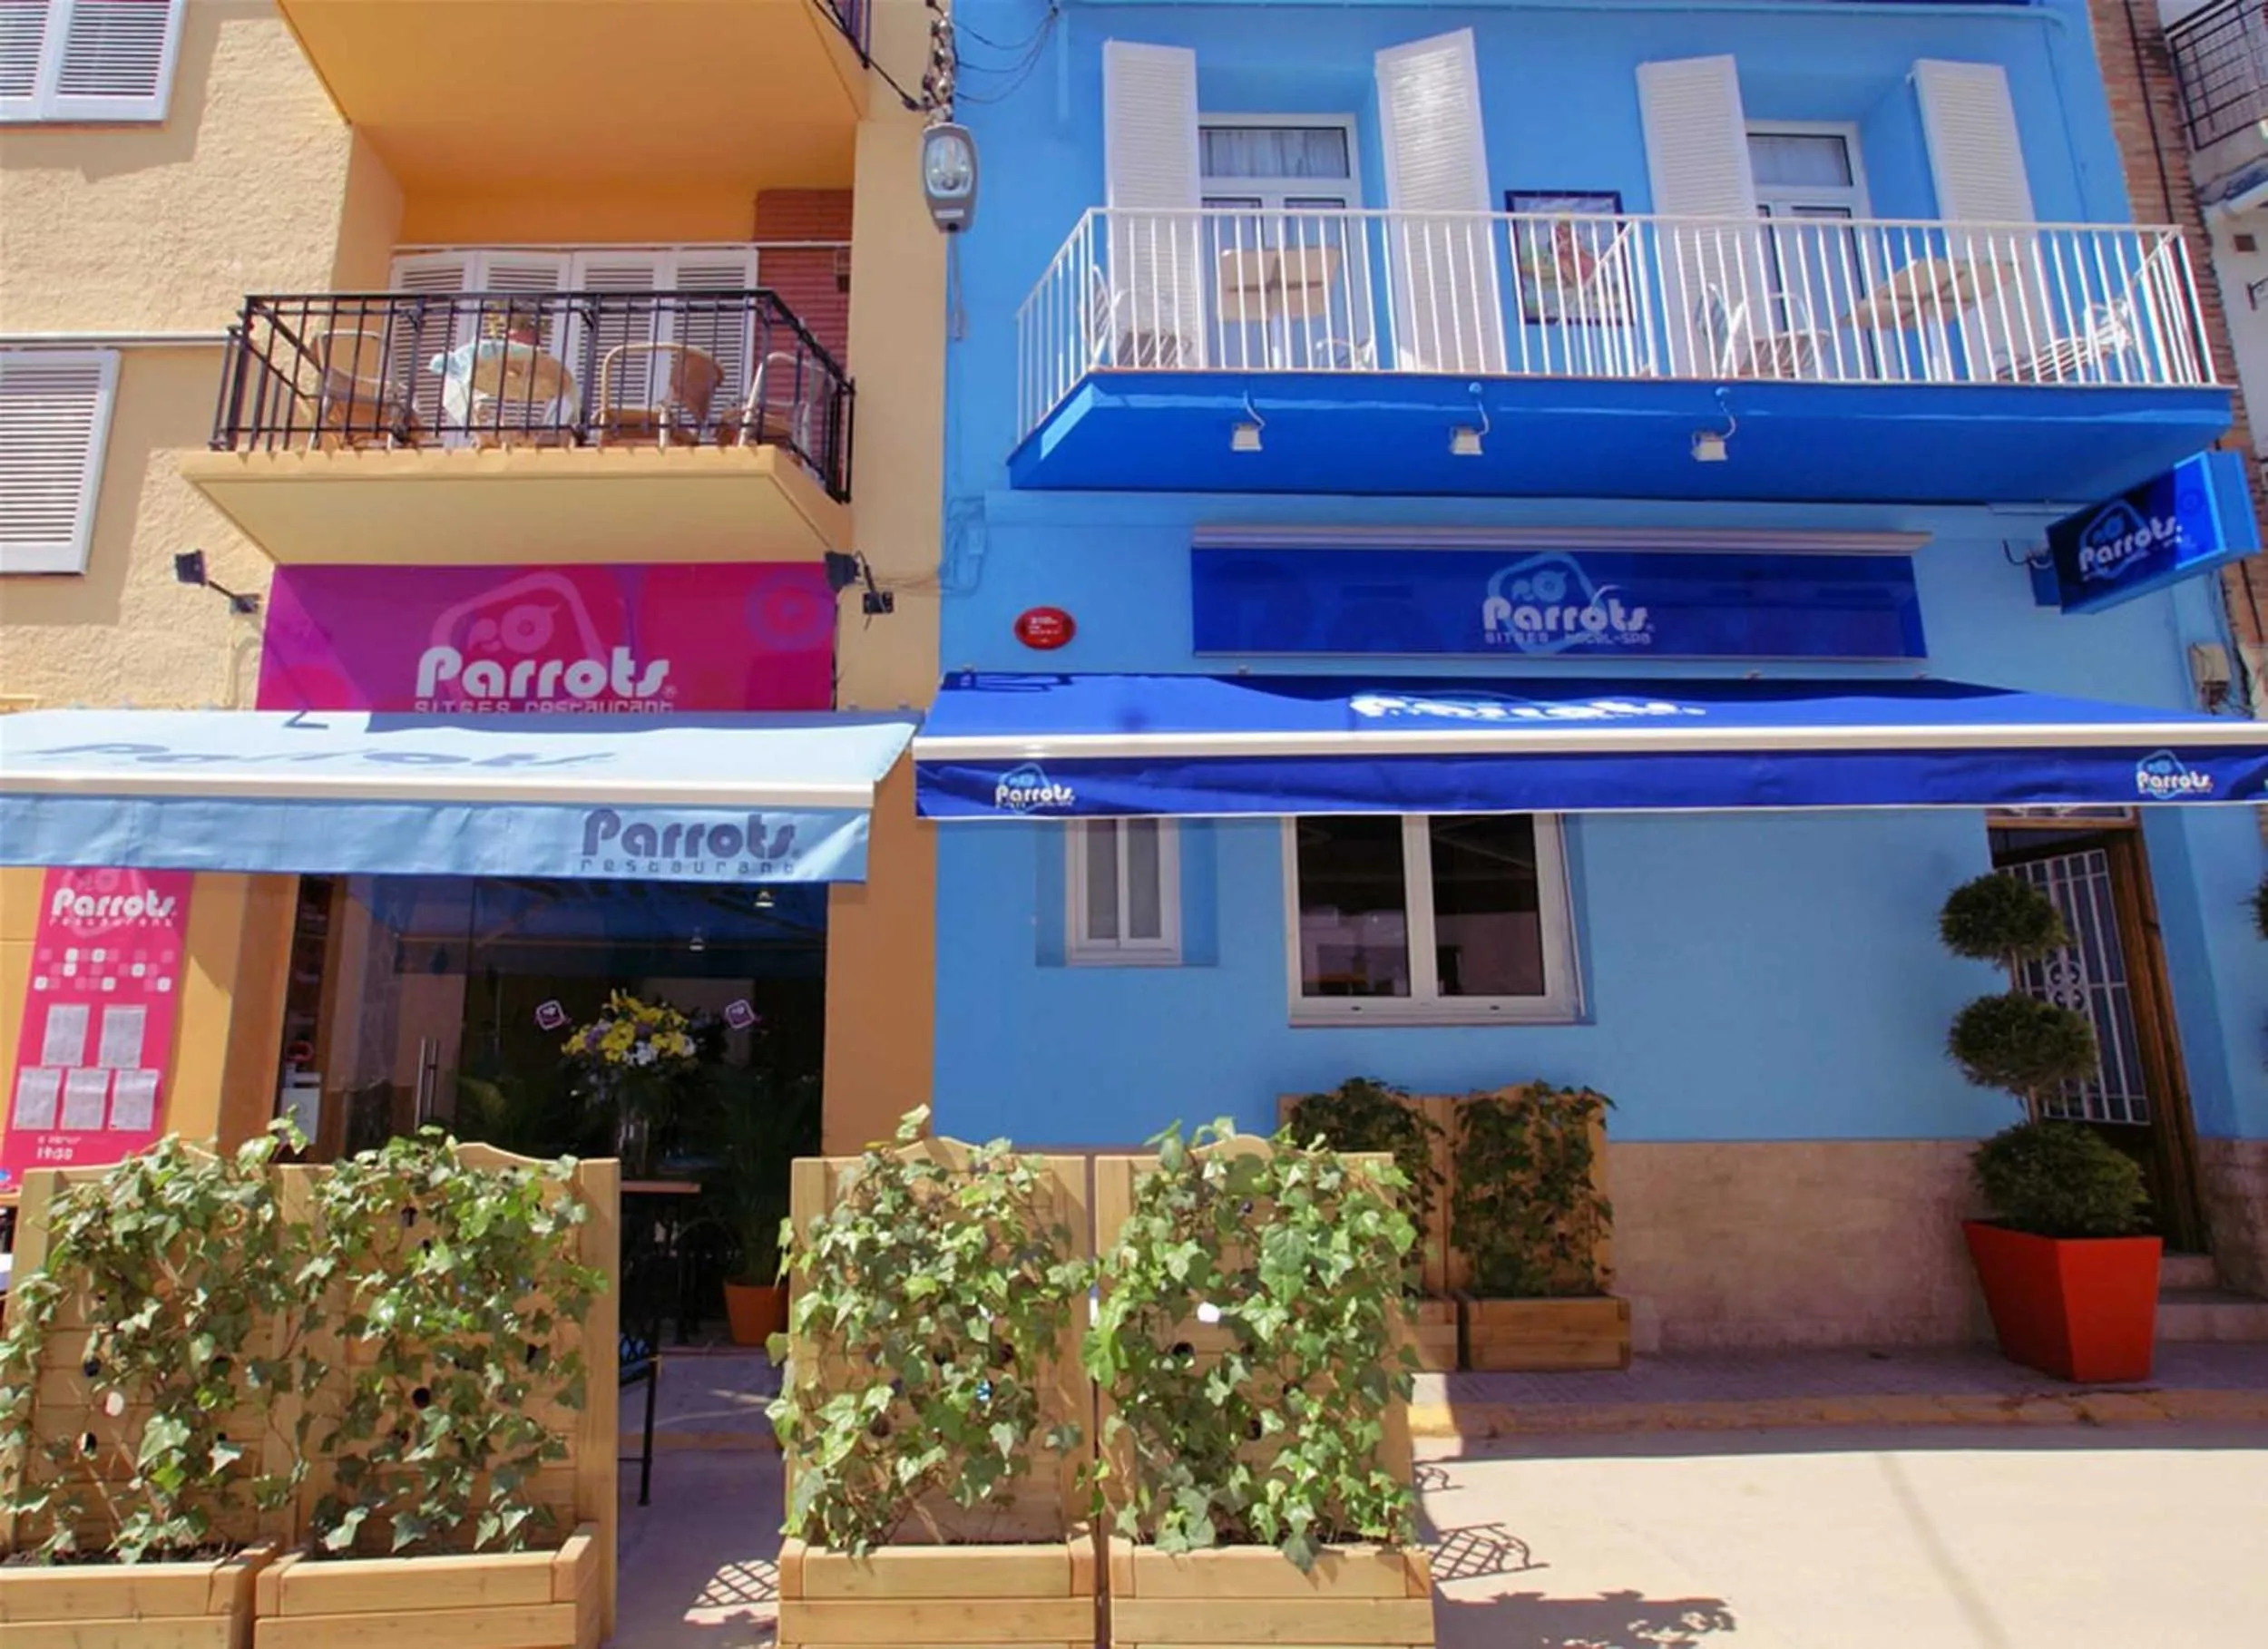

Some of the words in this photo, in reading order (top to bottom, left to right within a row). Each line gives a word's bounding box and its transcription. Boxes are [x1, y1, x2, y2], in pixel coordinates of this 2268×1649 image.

[2079, 516, 2176, 572] Parrots
[1482, 596, 1647, 631] Parrots
[415, 646, 670, 698] Parrots
[995, 783, 1072, 803] Parrots
[2136, 771, 2210, 788] Parrots
[582, 807, 795, 859] Parrots
[581, 859, 795, 873] restaurant
[51, 887, 176, 918] Parrots
